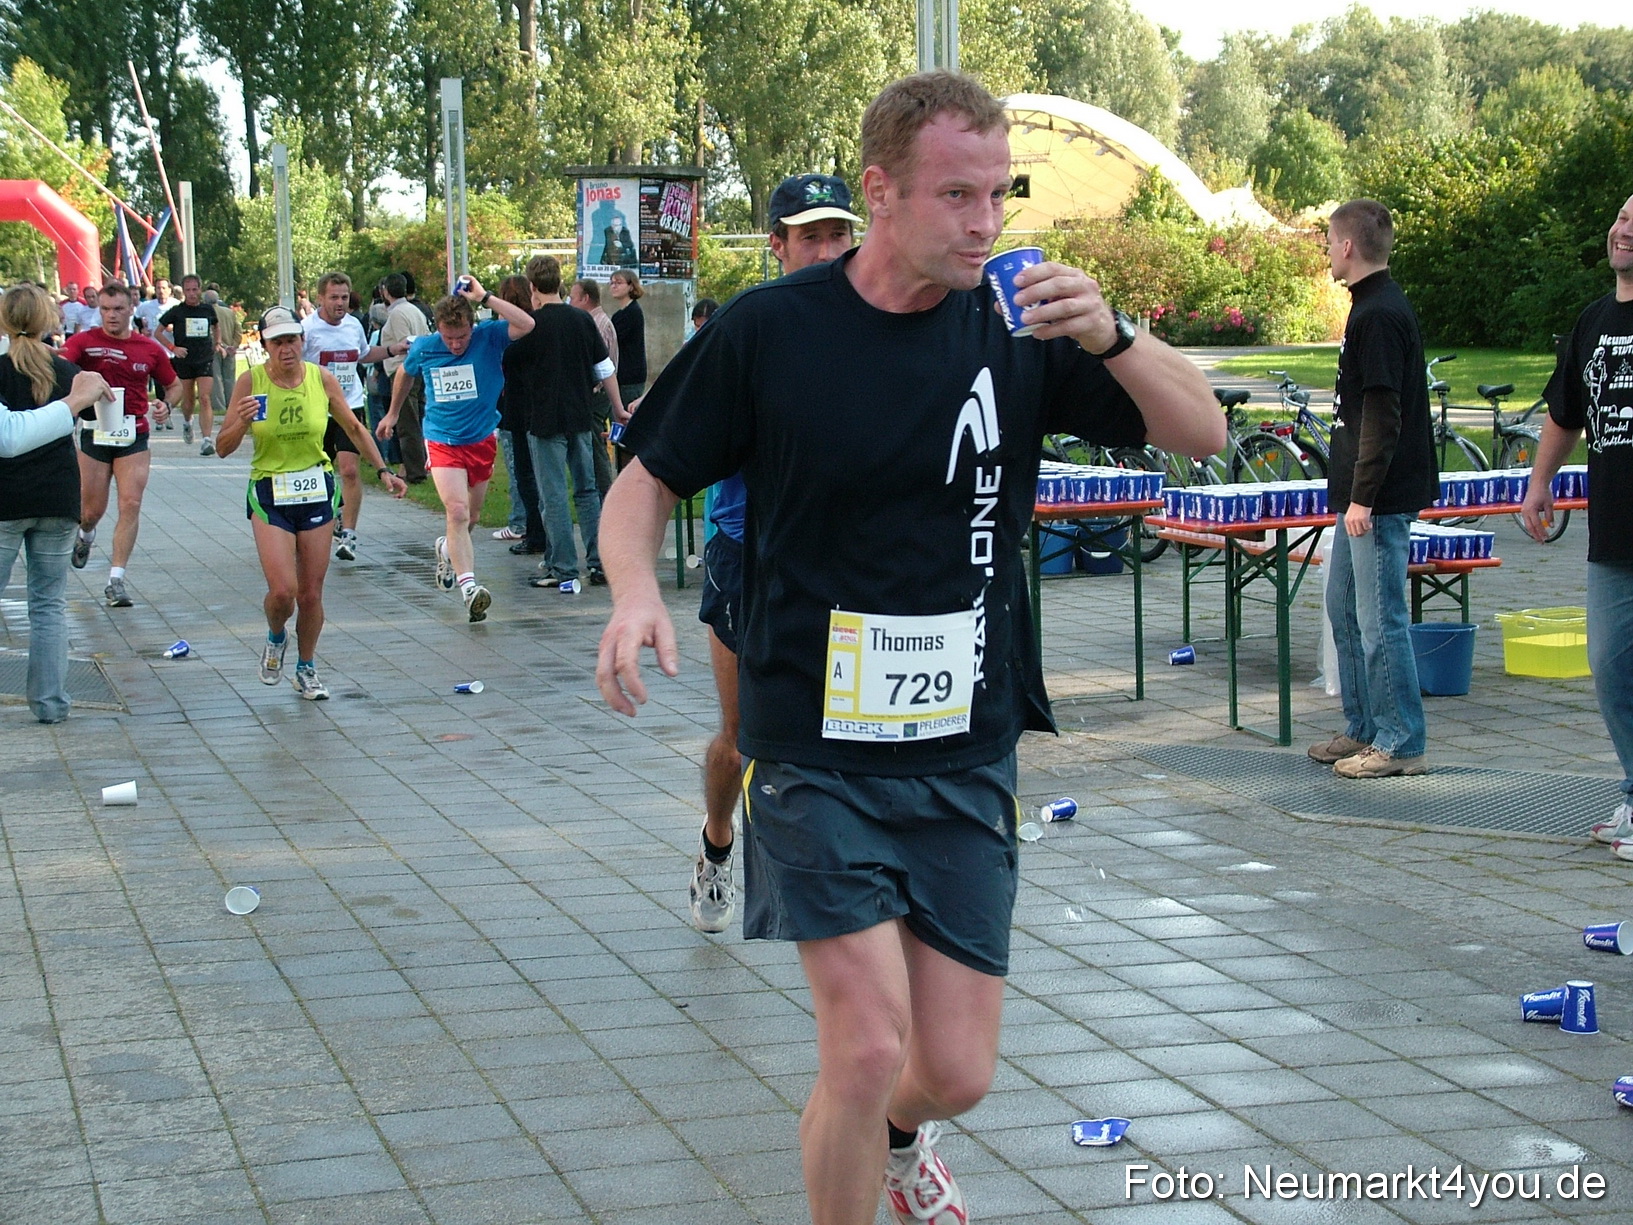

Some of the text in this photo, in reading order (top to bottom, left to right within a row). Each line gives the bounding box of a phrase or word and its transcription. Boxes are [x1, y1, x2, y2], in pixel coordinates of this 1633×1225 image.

[442, 369, 459, 377] Jakob
[445, 380, 473, 392] 2426
[293, 478, 318, 492] 928
[870, 627, 944, 652] Thomas
[833, 661, 843, 679] A
[885, 670, 953, 706] 729
[919, 714, 968, 731] PFLEIDERER
